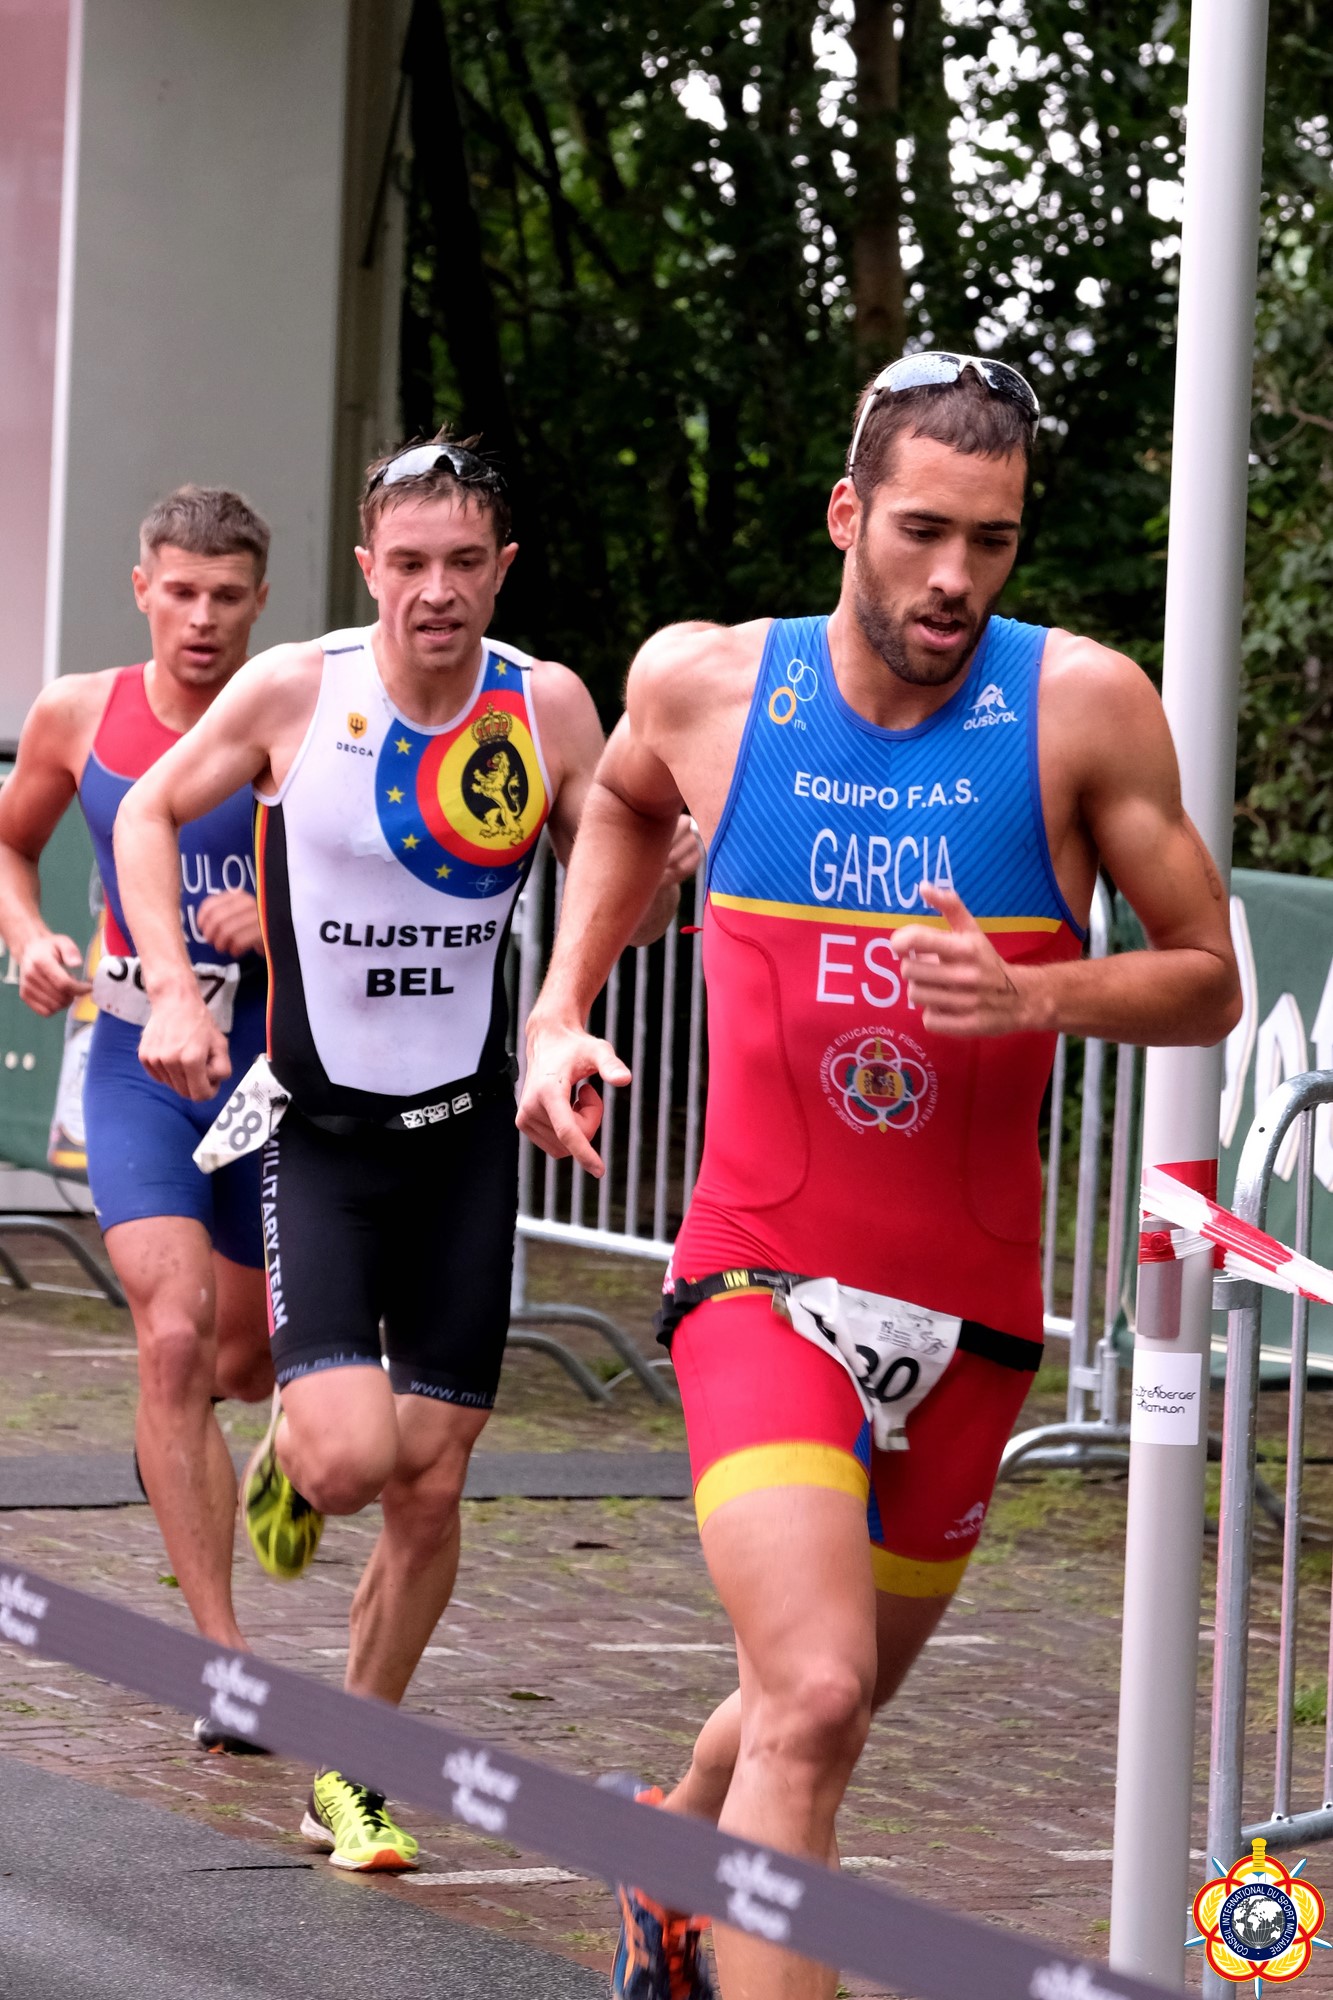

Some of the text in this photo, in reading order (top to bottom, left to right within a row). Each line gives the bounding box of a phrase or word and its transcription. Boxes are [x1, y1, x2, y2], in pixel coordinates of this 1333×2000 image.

[336, 741, 374, 758] DECCA
[794, 771, 980, 810] EQUIPO F.A.S.
[810, 828, 955, 909] GARCIA
[319, 920, 497, 948] CLIJSTERS
[366, 967, 454, 998] BEL
[816, 933, 917, 1010] ES
[820, 1046, 837, 1094] SUPERIOR
[268, 1255, 289, 1330] TEAM
